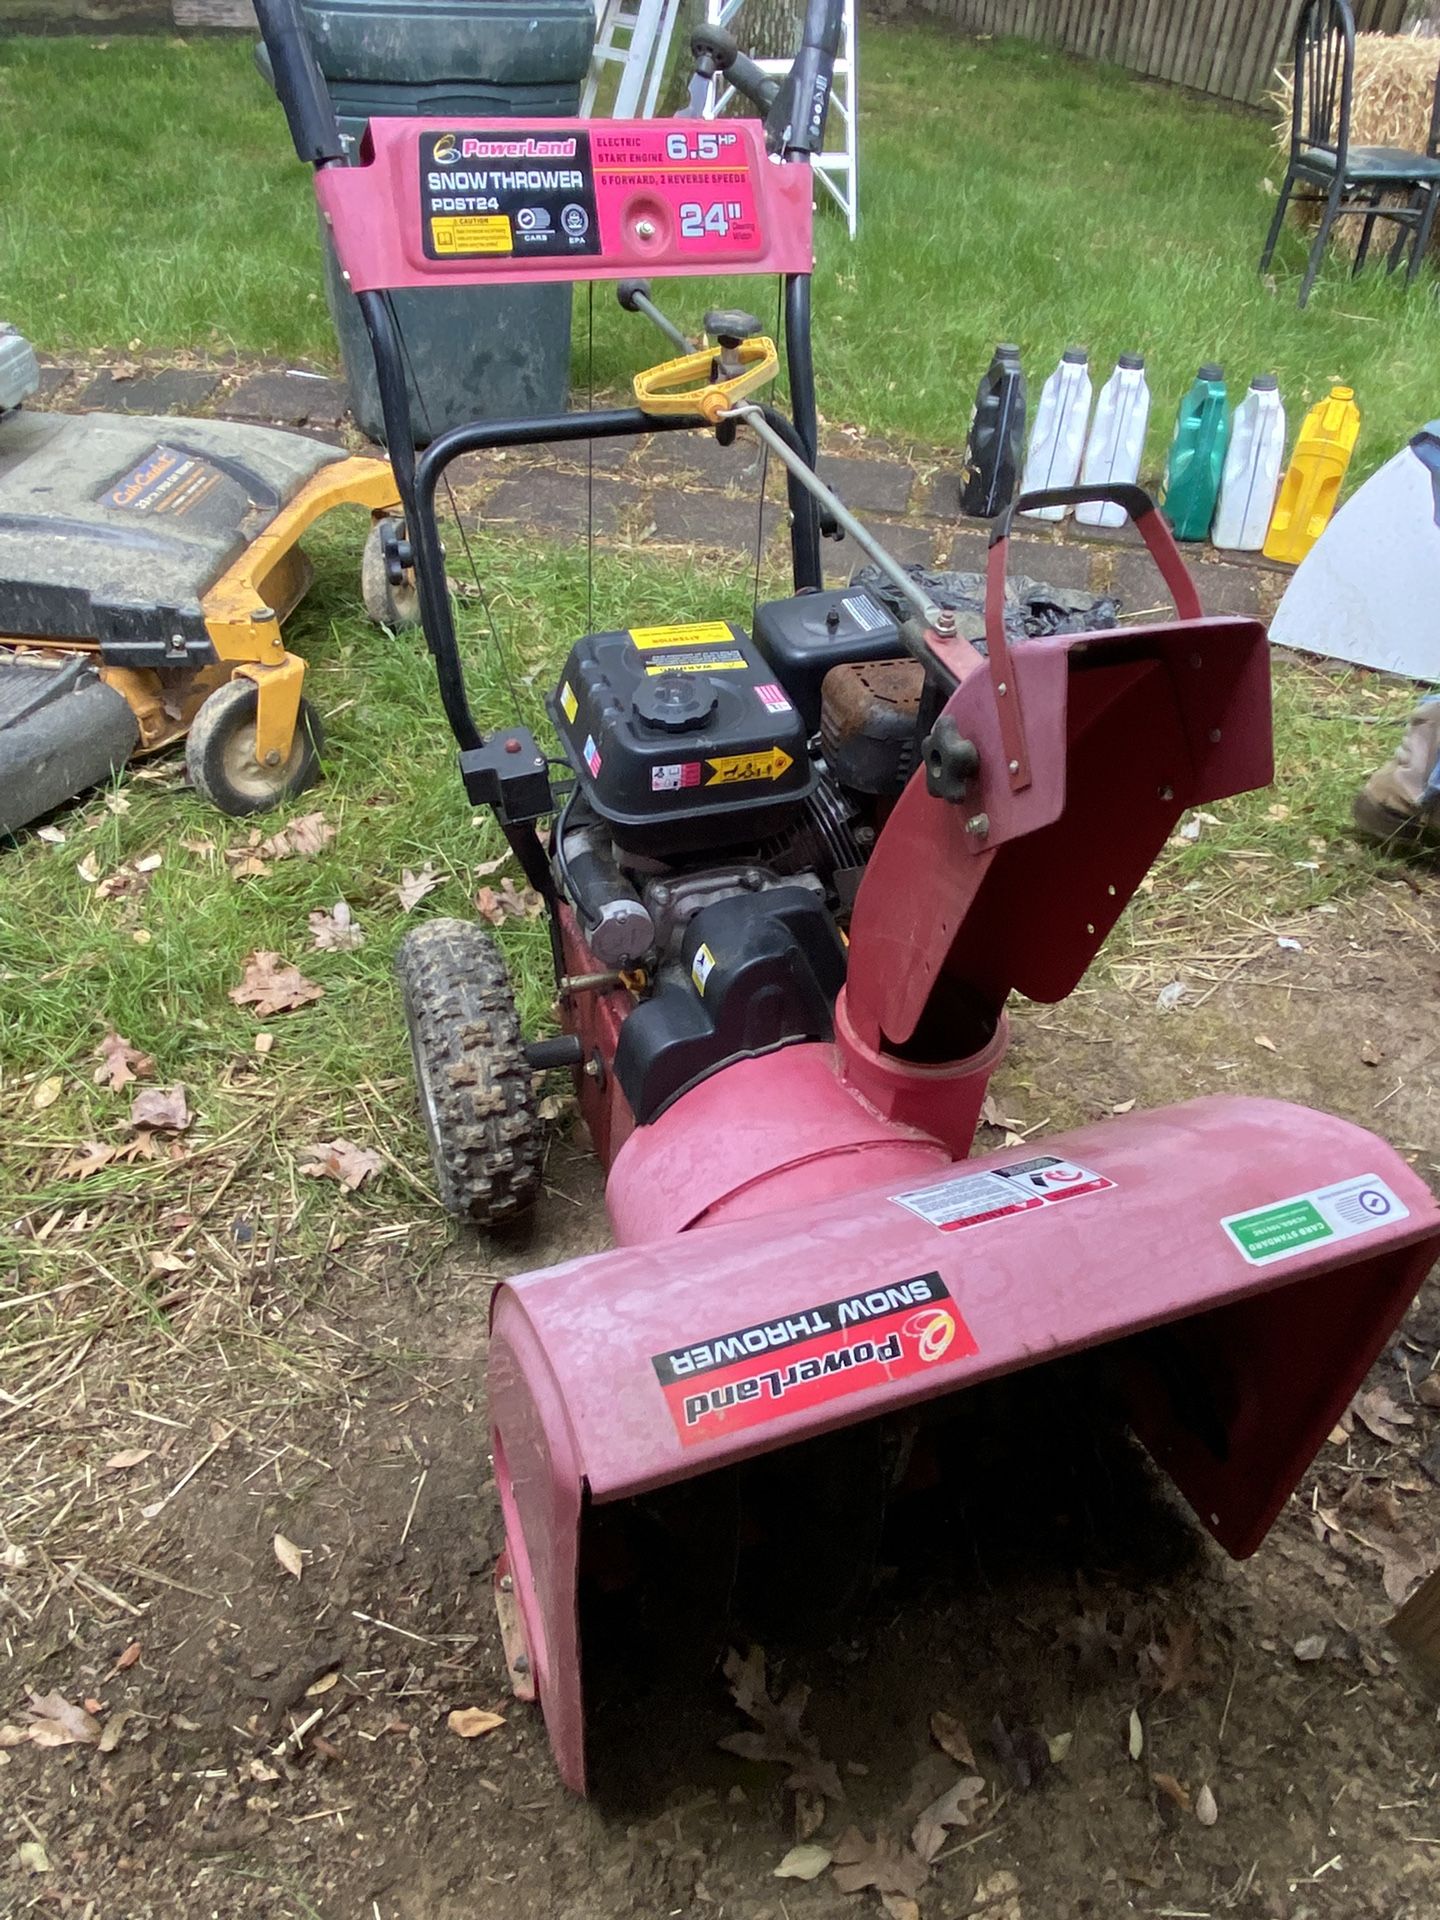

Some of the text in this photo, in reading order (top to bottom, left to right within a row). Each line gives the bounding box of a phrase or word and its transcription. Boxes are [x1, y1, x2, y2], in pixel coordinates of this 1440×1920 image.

[462, 138, 577, 158] PowerLand
[596, 137, 641, 147] ELECTRIC
[598, 153, 663, 163] START ENGINE
[427, 170, 584, 190] SNOW THROWER
[609, 175, 659, 186] FORWARD,
[660, 175, 667, 185] 2
[668, 174, 709, 185] REVERSE
[711, 173, 746, 184] SPEEDS
[430, 197, 500, 212] PDST24
[459, 217, 490, 225] CAUTION
[524, 234, 548, 242] CARB
[568, 236, 586, 245] EPA
[1247, 1229, 1298, 1252] STANDARD
[669, 1278, 932, 1375] SNOW THROWER
[684, 1330, 904, 1426] PowerLand
